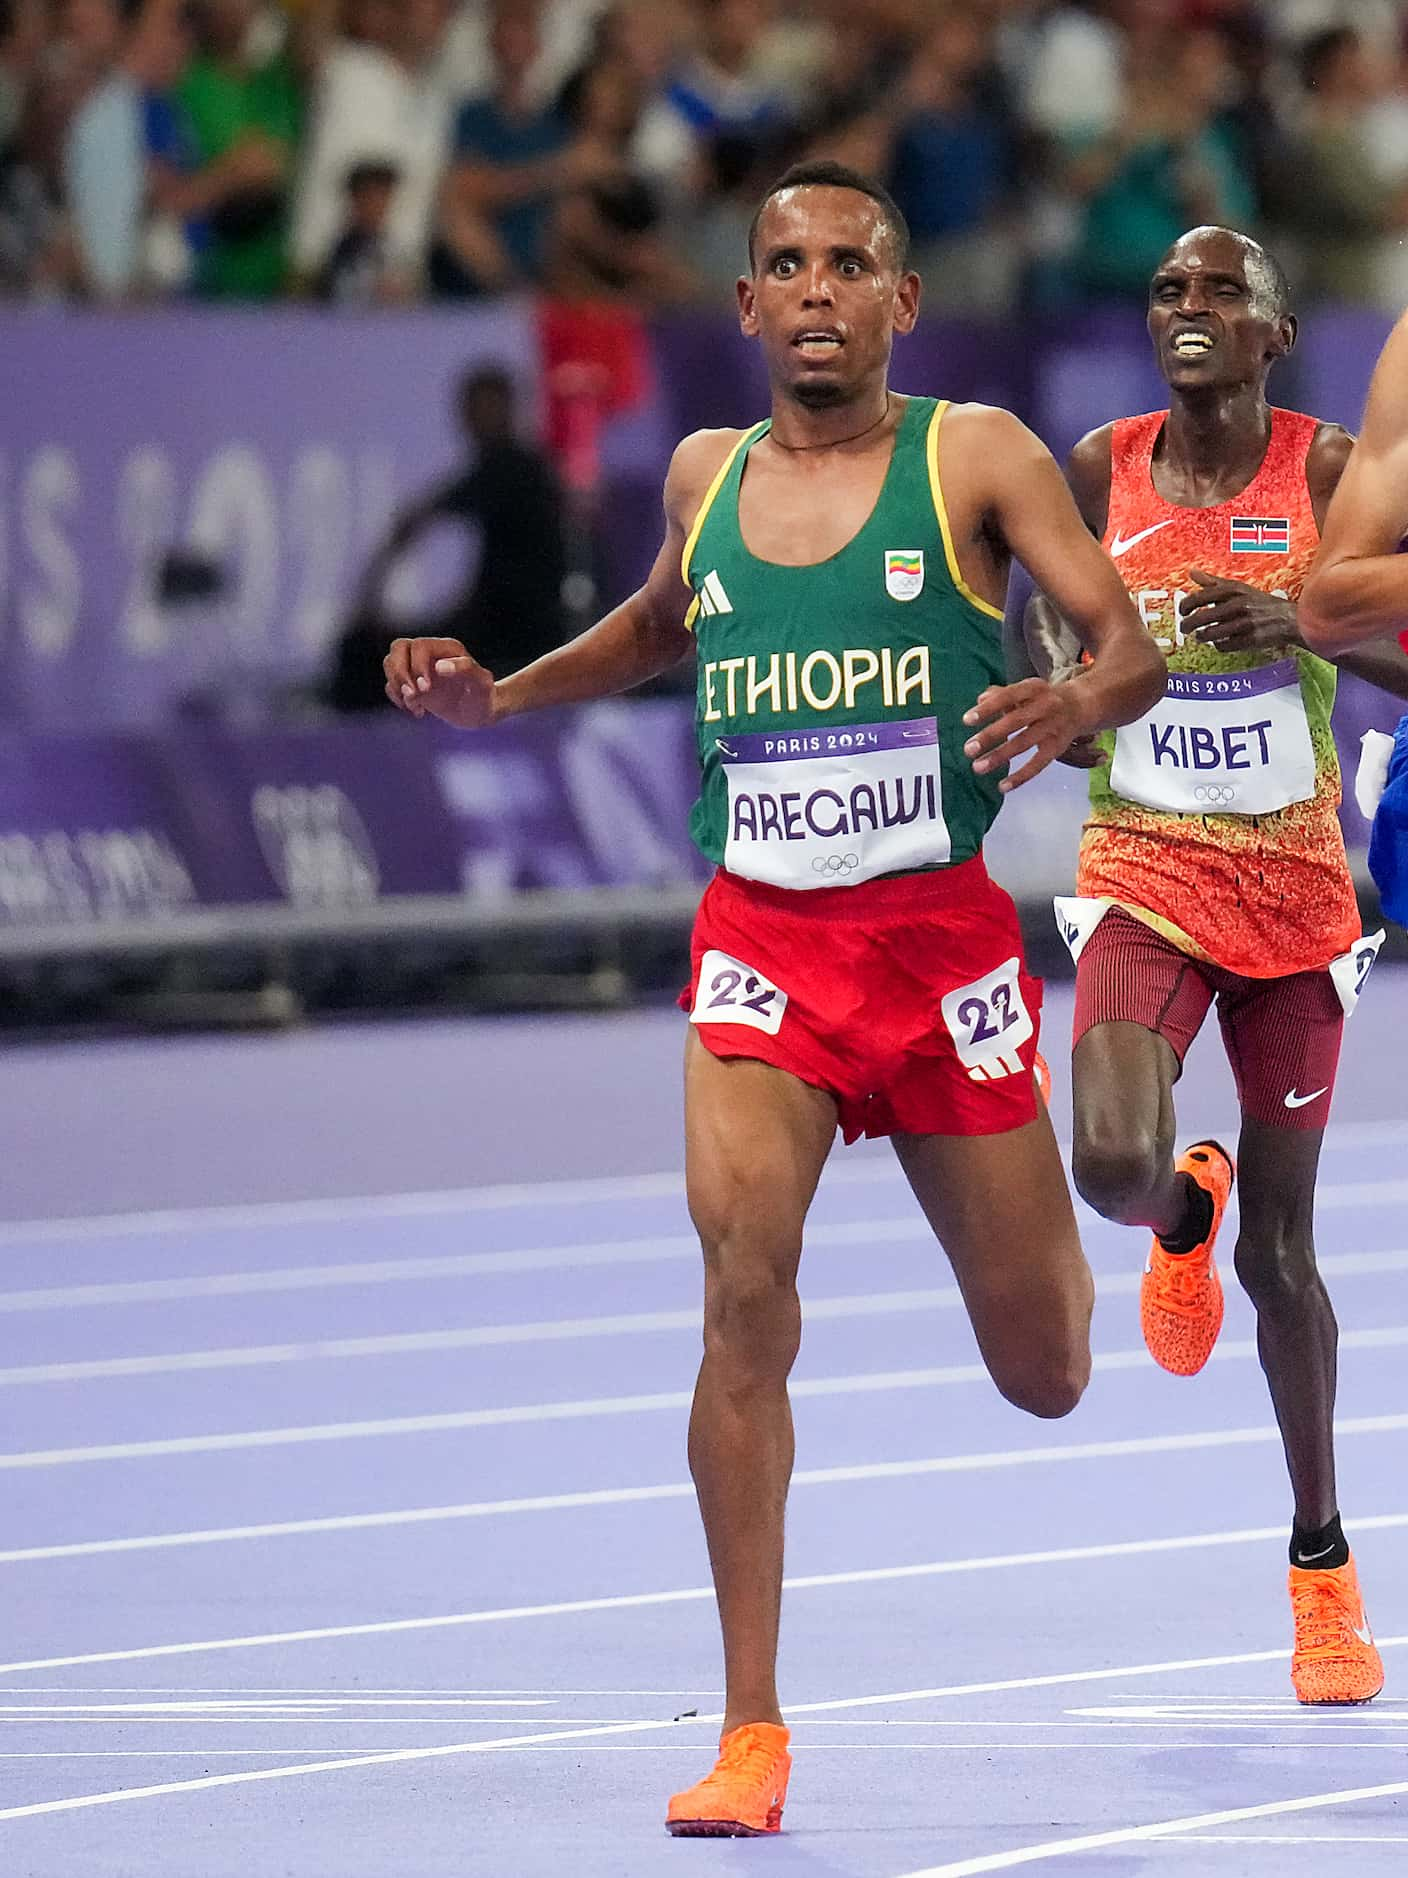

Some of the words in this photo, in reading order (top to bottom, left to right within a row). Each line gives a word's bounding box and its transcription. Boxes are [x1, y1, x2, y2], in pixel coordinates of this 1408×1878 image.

[704, 645, 931, 723] ETHIOPIA
[1166, 679, 1200, 693] ARIS
[1206, 680, 1252, 694] 2024
[764, 737, 820, 756] PARIS
[827, 732, 879, 750] 2024
[1149, 719, 1272, 770] KIBET
[733, 774, 937, 842] AREGAWI
[707, 969, 777, 1018] 22
[957, 983, 1020, 1046] 22
